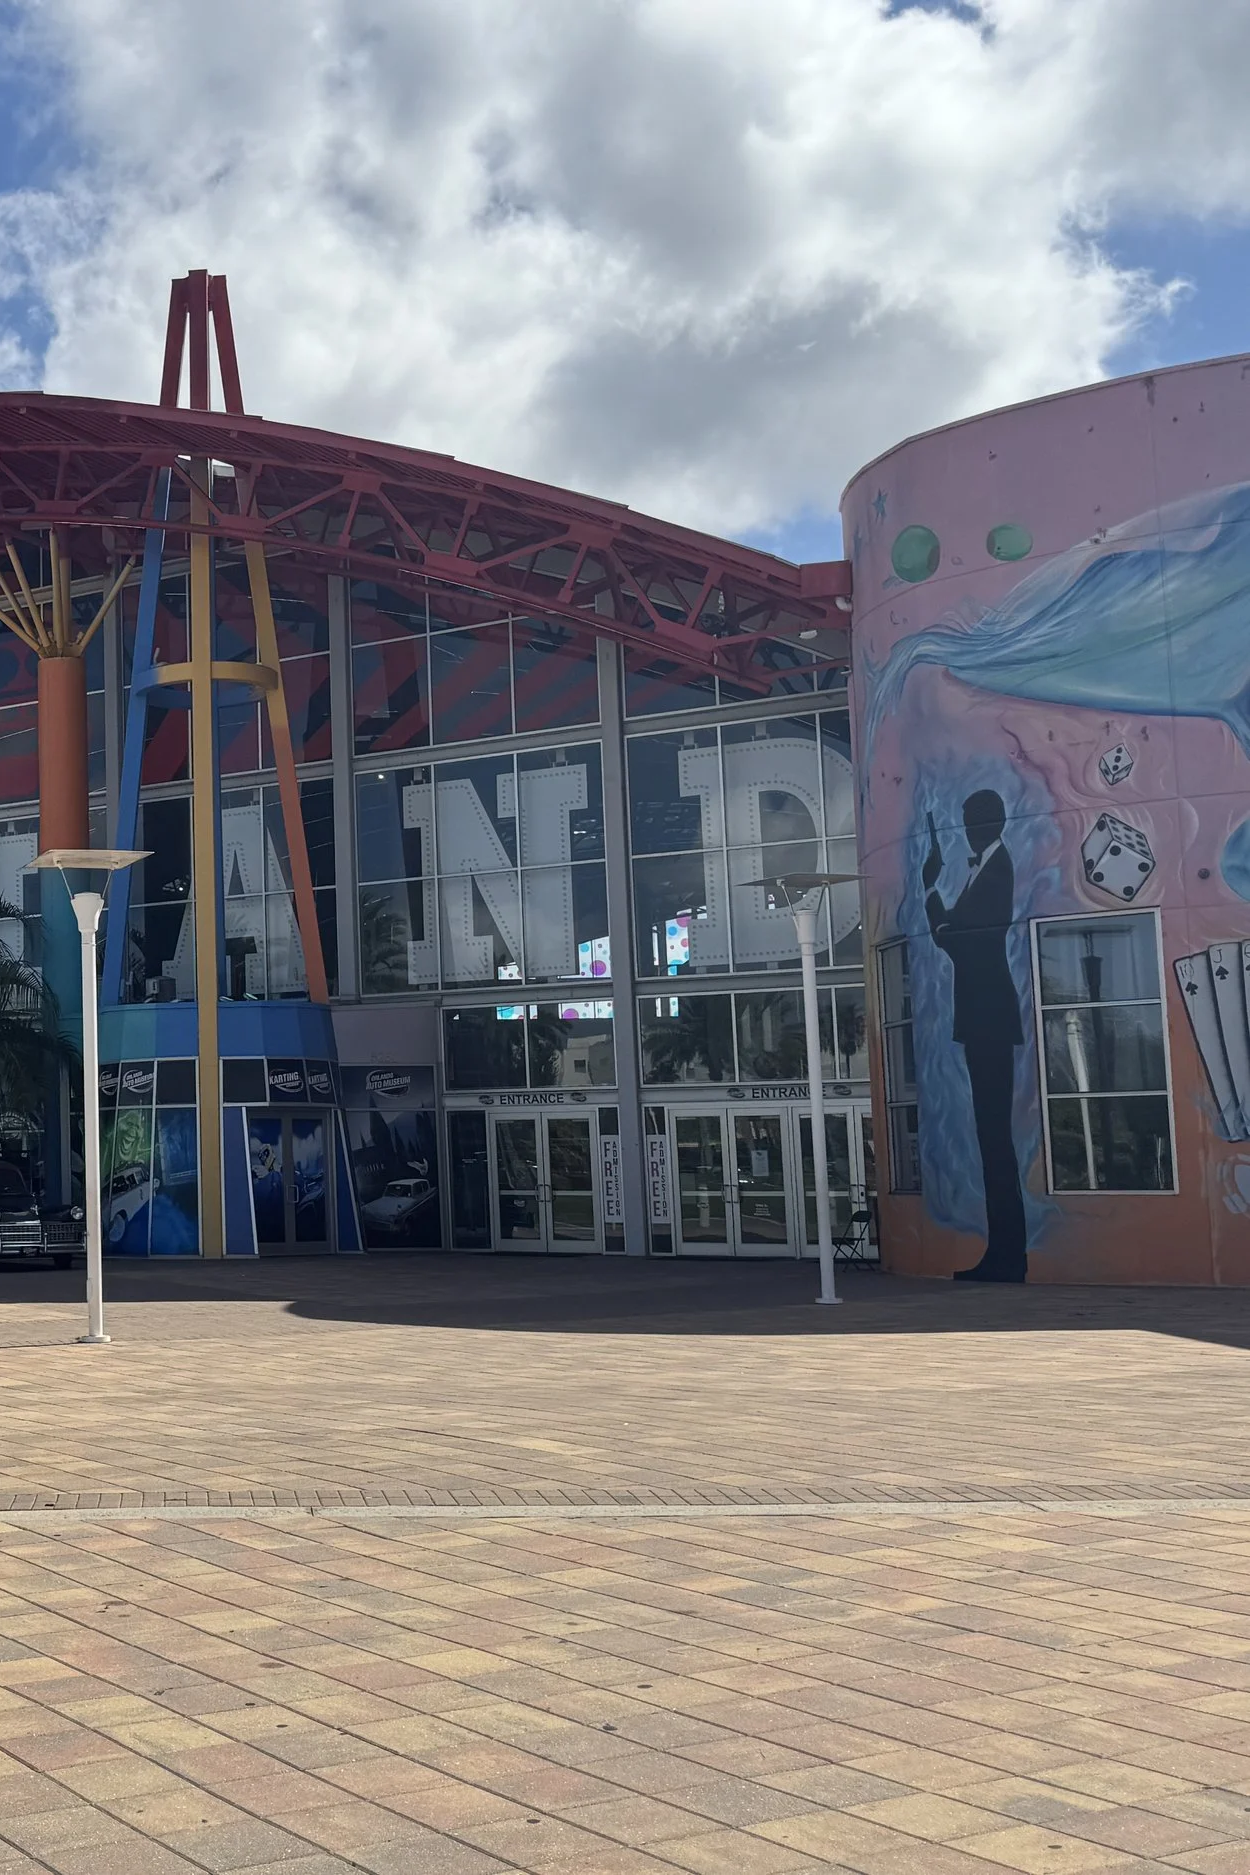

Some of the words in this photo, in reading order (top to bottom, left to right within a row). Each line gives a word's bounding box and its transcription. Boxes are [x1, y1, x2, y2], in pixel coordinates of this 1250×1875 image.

[269, 1071, 299, 1085] KARTING
[383, 1075, 411, 1088] MUSEUM
[500, 1093, 565, 1105] ENTRANCE
[752, 1086, 826, 1099] ENTRAN
[603, 1141, 615, 1216] FREE
[612, 1141, 621, 1217] ADMISSION
[650, 1141, 661, 1217] FREE
[659, 1141, 668, 1217] ADMISSION
